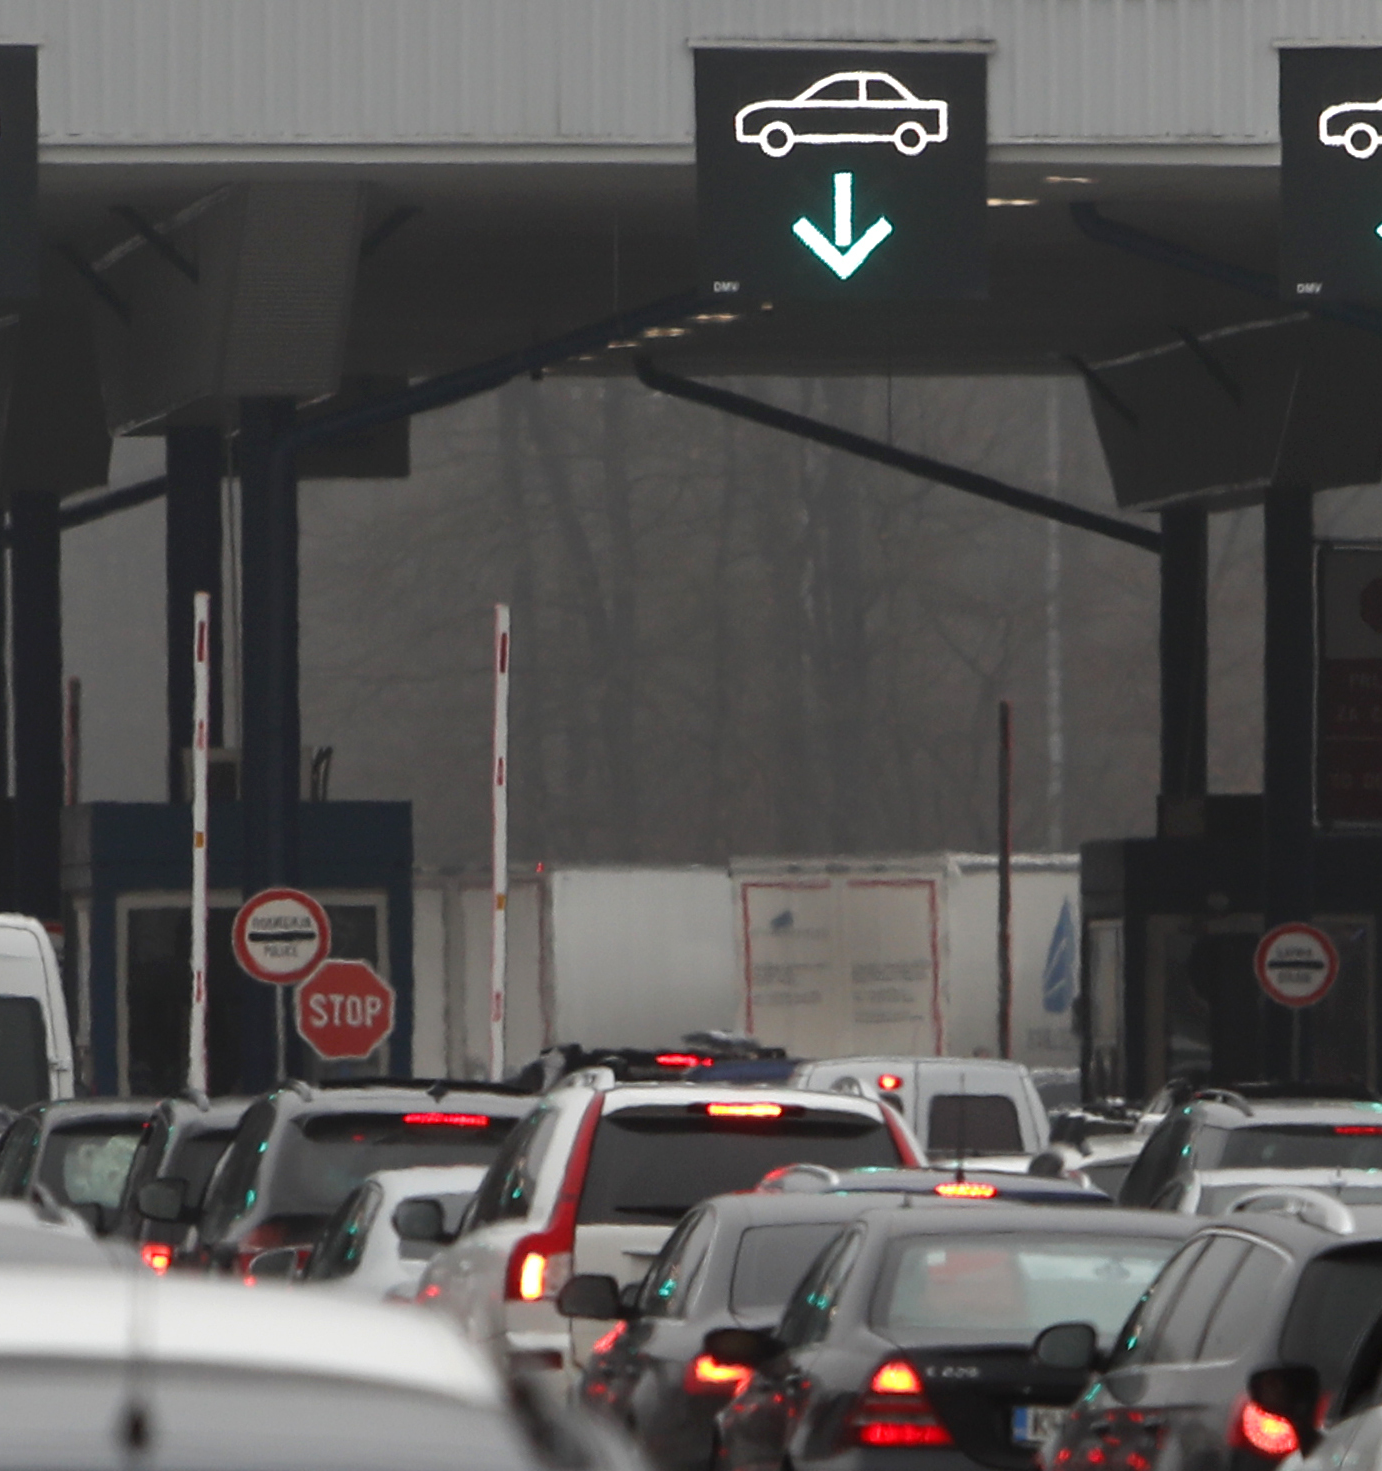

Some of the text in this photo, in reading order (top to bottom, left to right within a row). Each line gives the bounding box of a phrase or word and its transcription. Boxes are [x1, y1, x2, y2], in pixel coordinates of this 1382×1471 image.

[713, 281, 739, 292] DMV
[1297, 283, 1322, 293] DMV
[309, 992, 382, 1028] STOP
